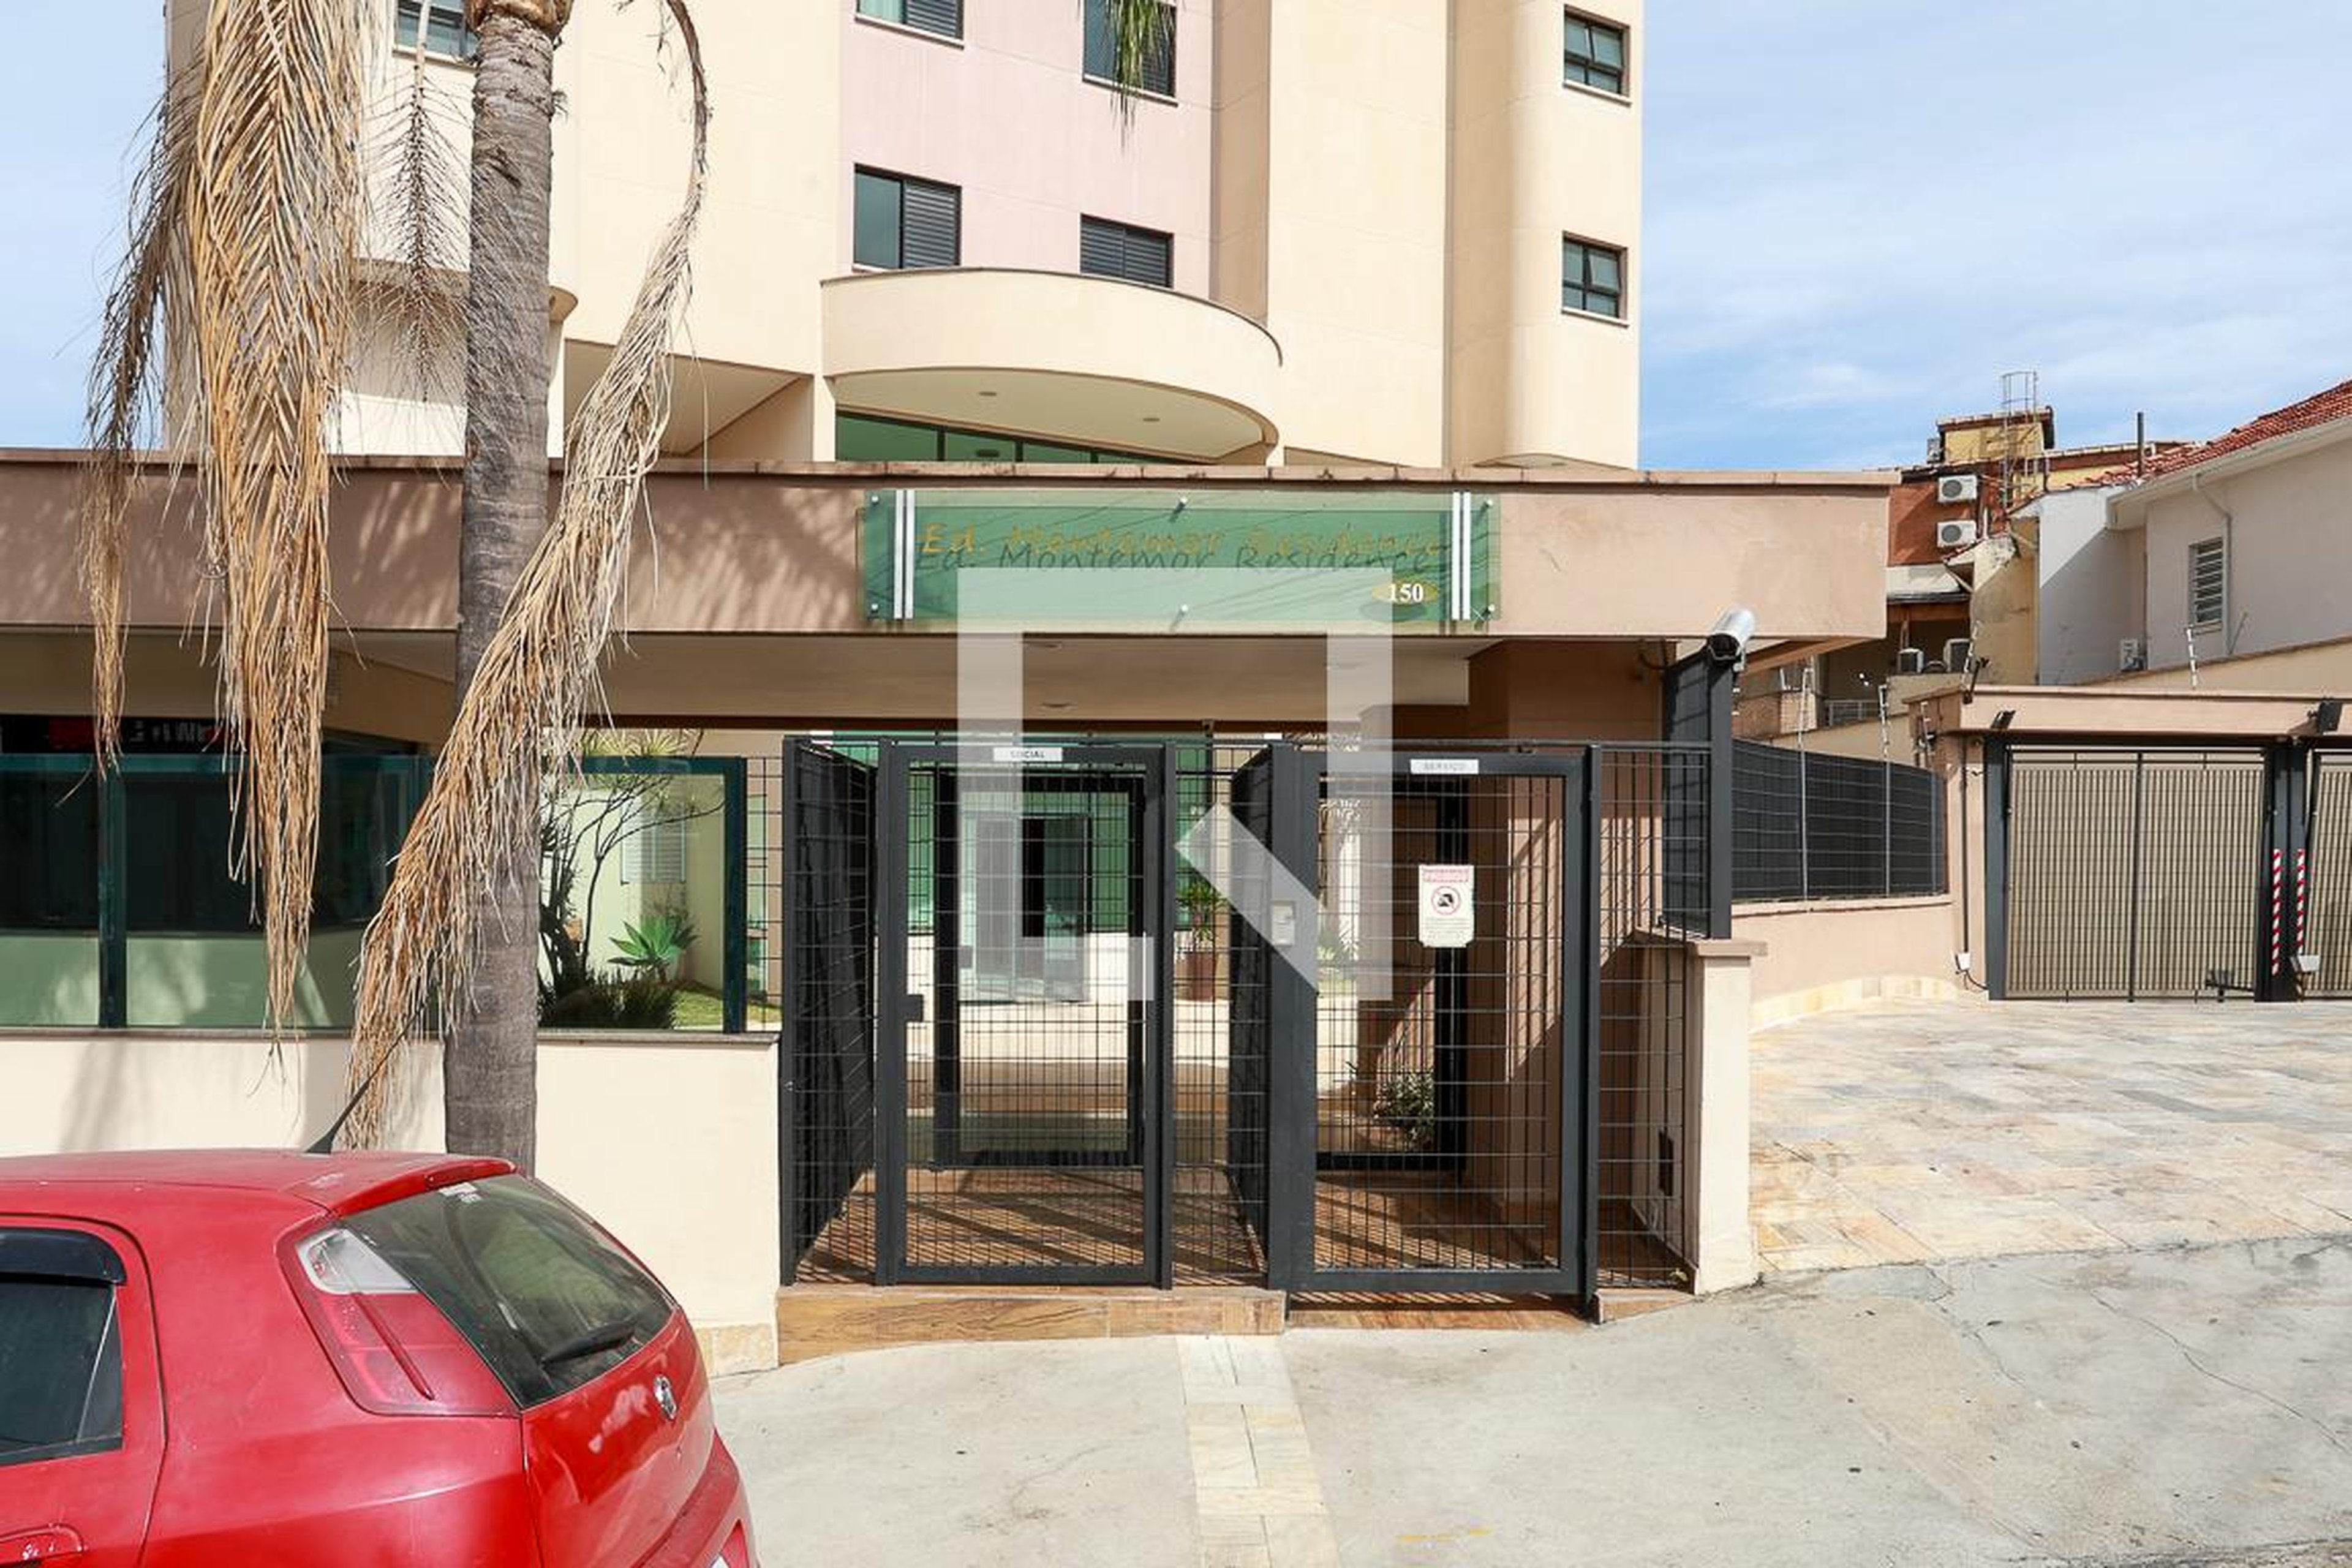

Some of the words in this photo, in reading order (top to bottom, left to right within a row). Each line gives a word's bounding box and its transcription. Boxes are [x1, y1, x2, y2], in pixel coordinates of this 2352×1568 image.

[1008, 524, 1222, 560] Montemor
[1247, 525, 1439, 560] Residence
[1388, 583, 1424, 602] 150
[1011, 750, 1045, 759] SOCIAL
